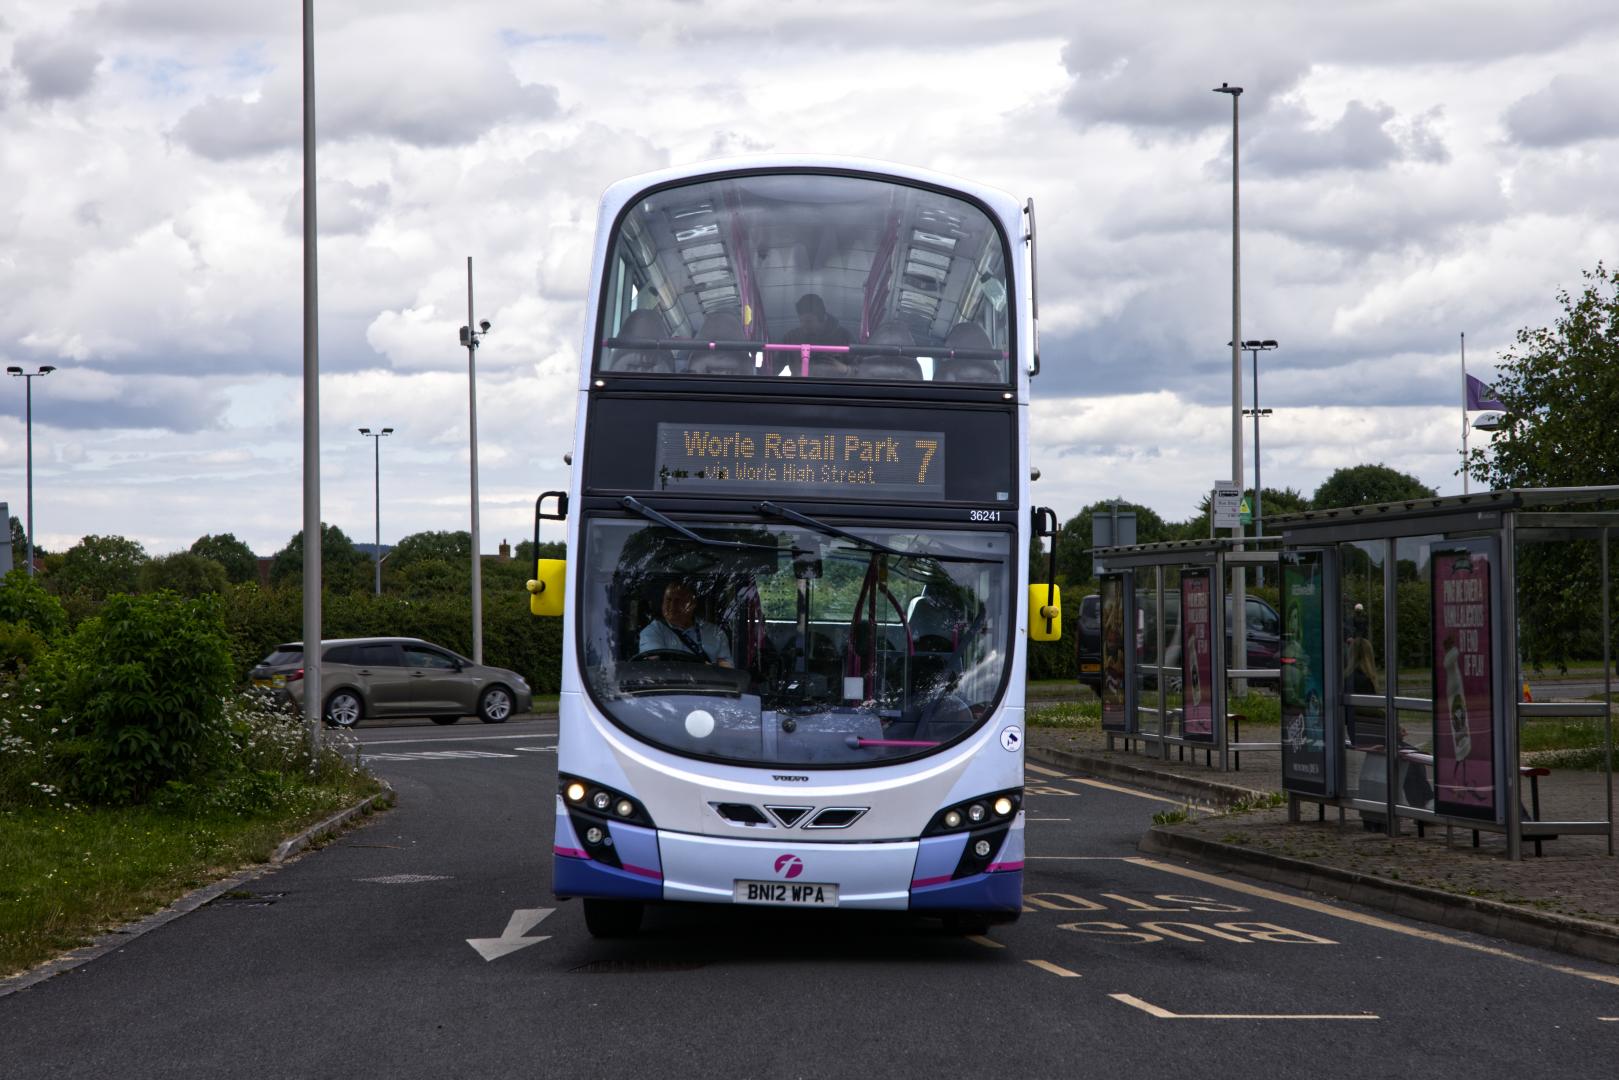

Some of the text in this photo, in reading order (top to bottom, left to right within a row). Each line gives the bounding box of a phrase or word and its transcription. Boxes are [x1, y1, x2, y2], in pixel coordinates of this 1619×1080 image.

[684, 431, 899, 462] Worle Retail Park
[705, 461, 876, 484] via Worle High Street
[915, 440, 938, 484] 7
[970, 510, 1000, 521] 36241
[748, 883, 825, 903] BN12 WPA
[1023, 892, 1251, 912] STO
[1056, 921, 1341, 944] BUS
